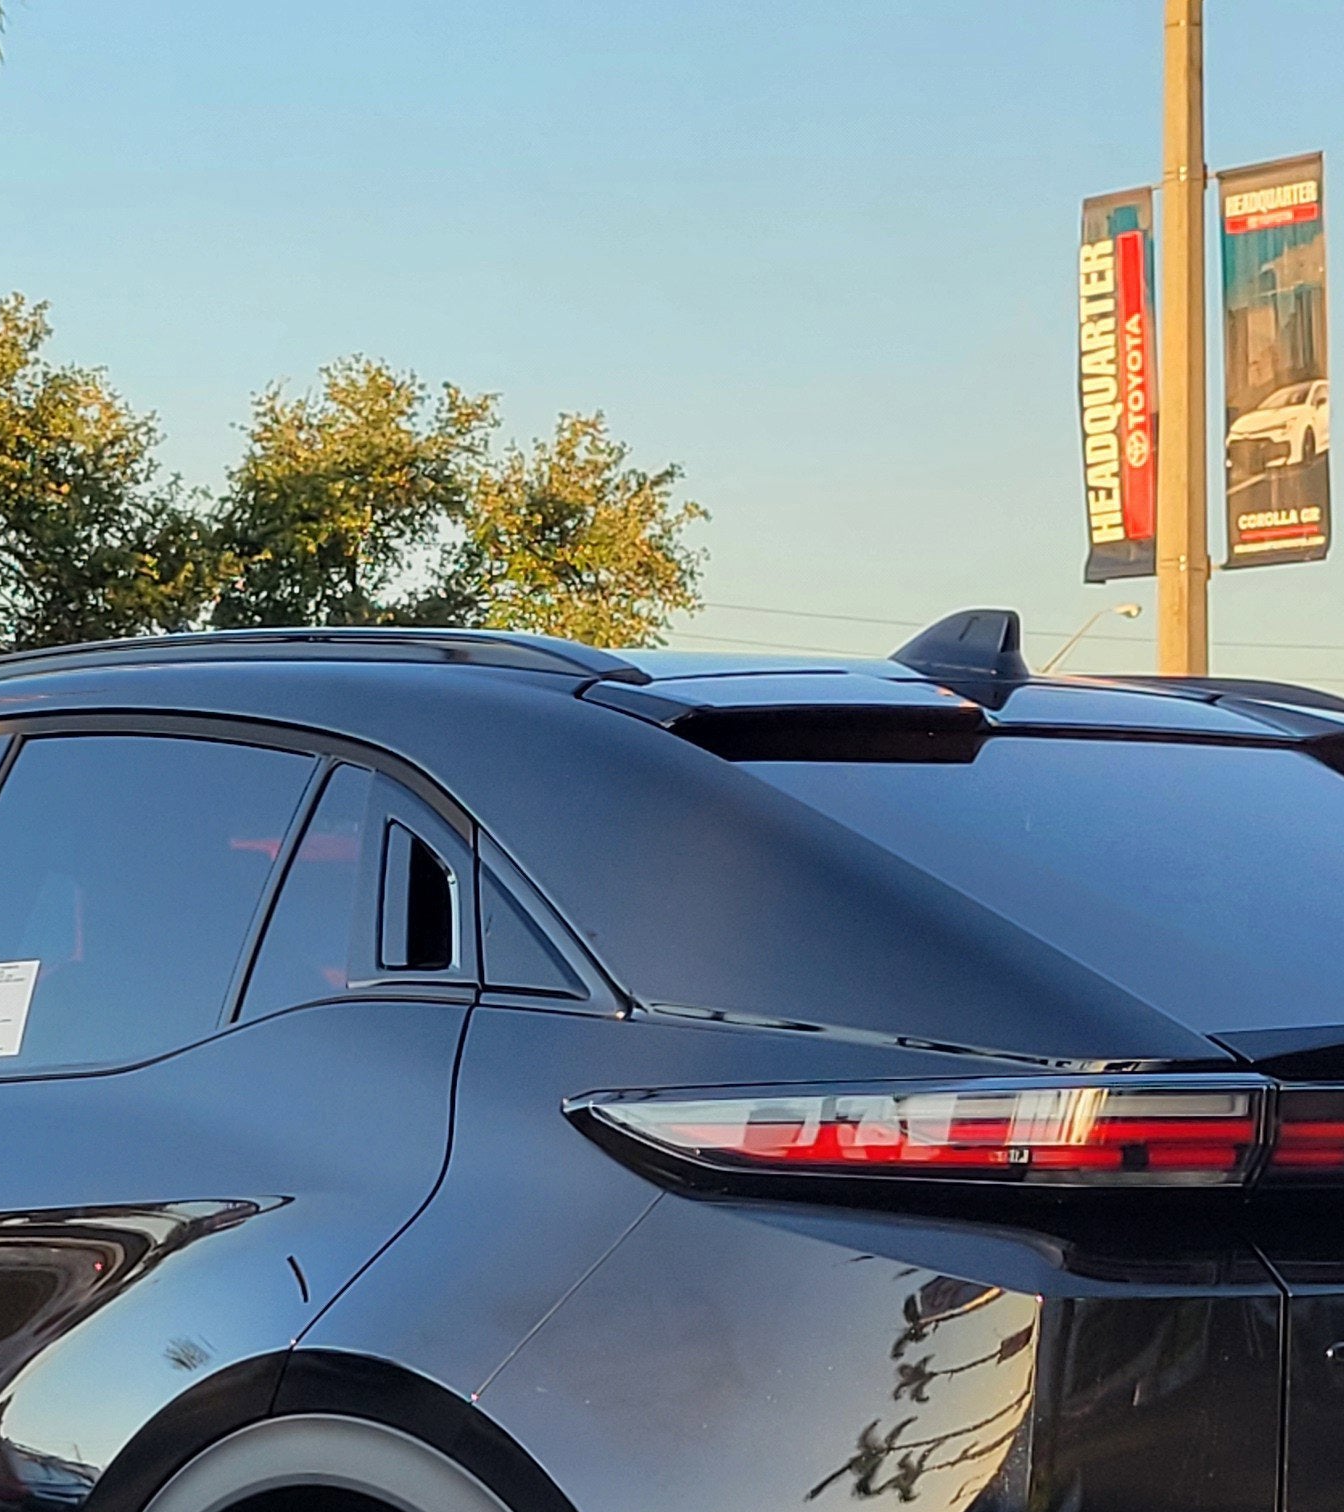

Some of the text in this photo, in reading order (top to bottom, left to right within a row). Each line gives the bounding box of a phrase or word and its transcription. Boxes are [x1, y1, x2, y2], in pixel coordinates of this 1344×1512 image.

[1080, 238, 1125, 544] HEADQUARTER
[1125, 313, 1148, 429] TOYOTA
[1238, 508, 1299, 530] COROLLA
